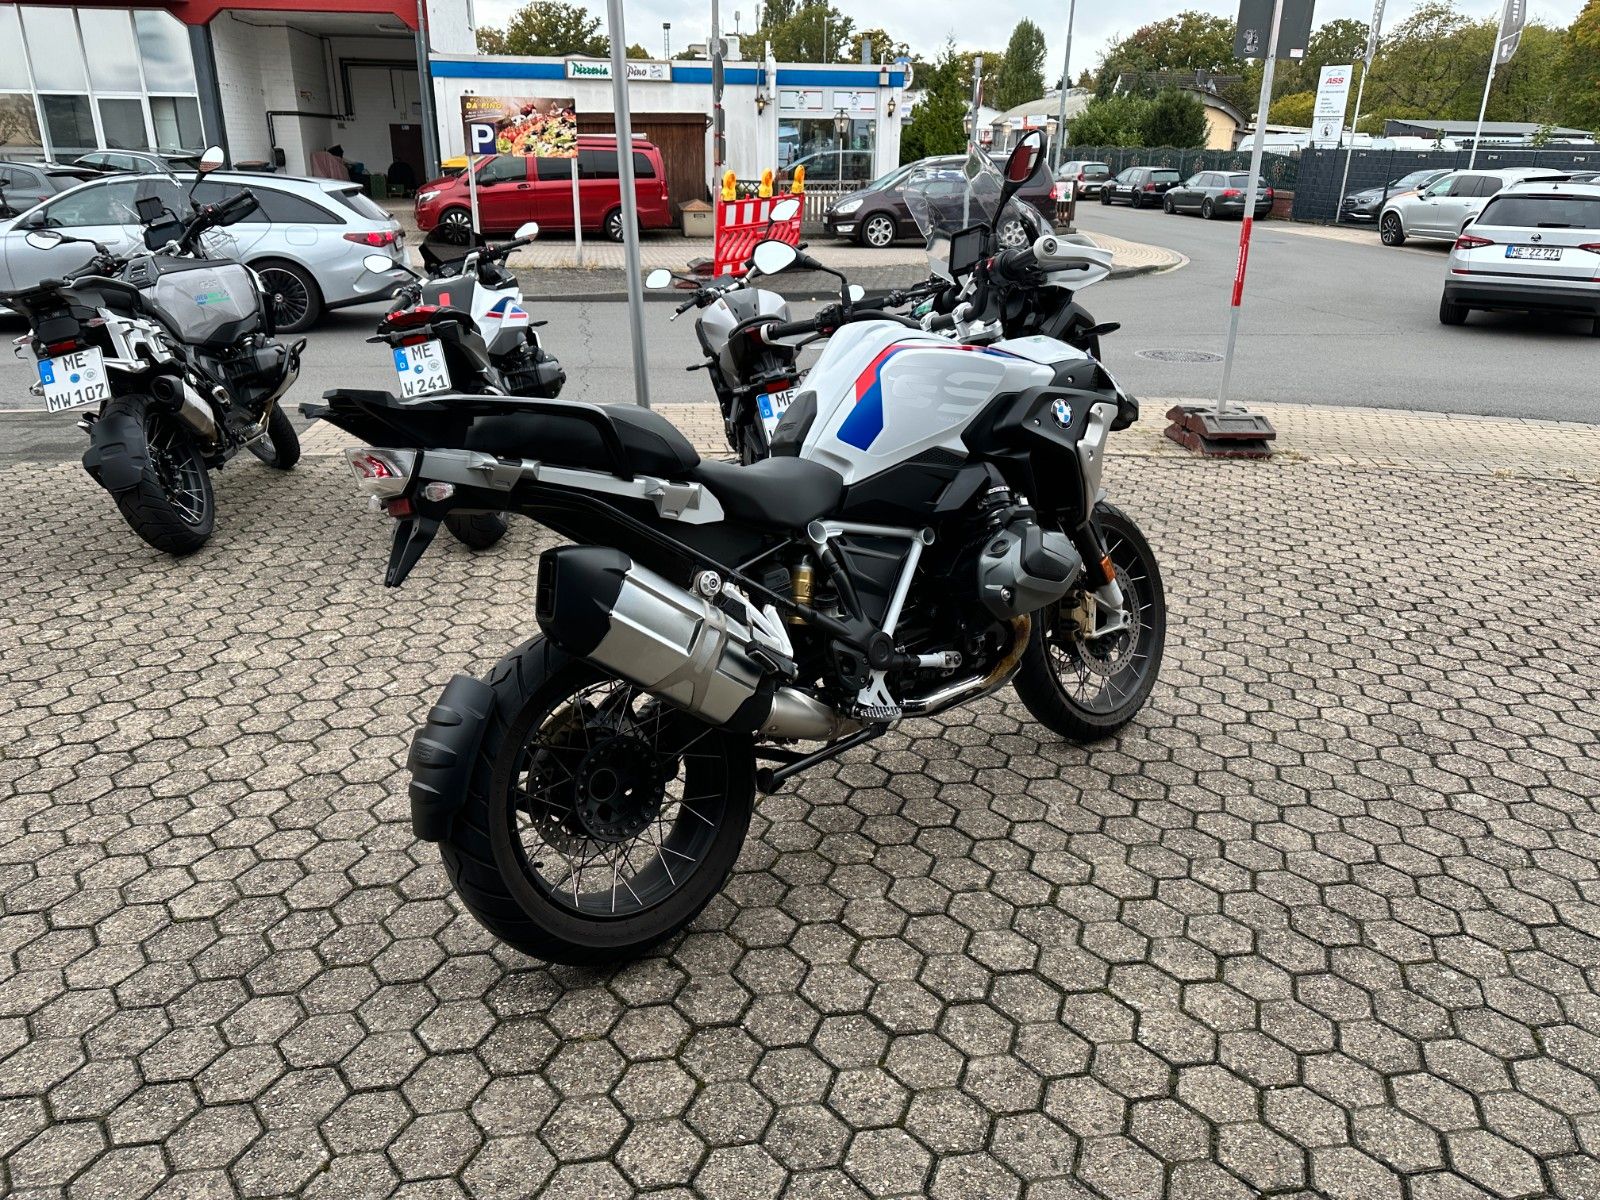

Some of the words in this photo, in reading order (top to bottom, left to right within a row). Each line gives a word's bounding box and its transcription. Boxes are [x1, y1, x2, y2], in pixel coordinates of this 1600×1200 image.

[572, 62, 609, 76] Pizzeria
[481, 102, 502, 110] PINO
[471, 124, 493, 153] P
[1512, 247, 1525, 256] ME
[1529, 248, 1542, 257] ZZ
[1543, 249, 1560, 257] 771
[411, 343, 434, 361] ME
[63, 353, 87, 371] ME
[403, 381, 415, 396] W
[416, 374, 448, 394] 241
[48, 391, 72, 411] MW
[74, 382, 105, 404] 107
